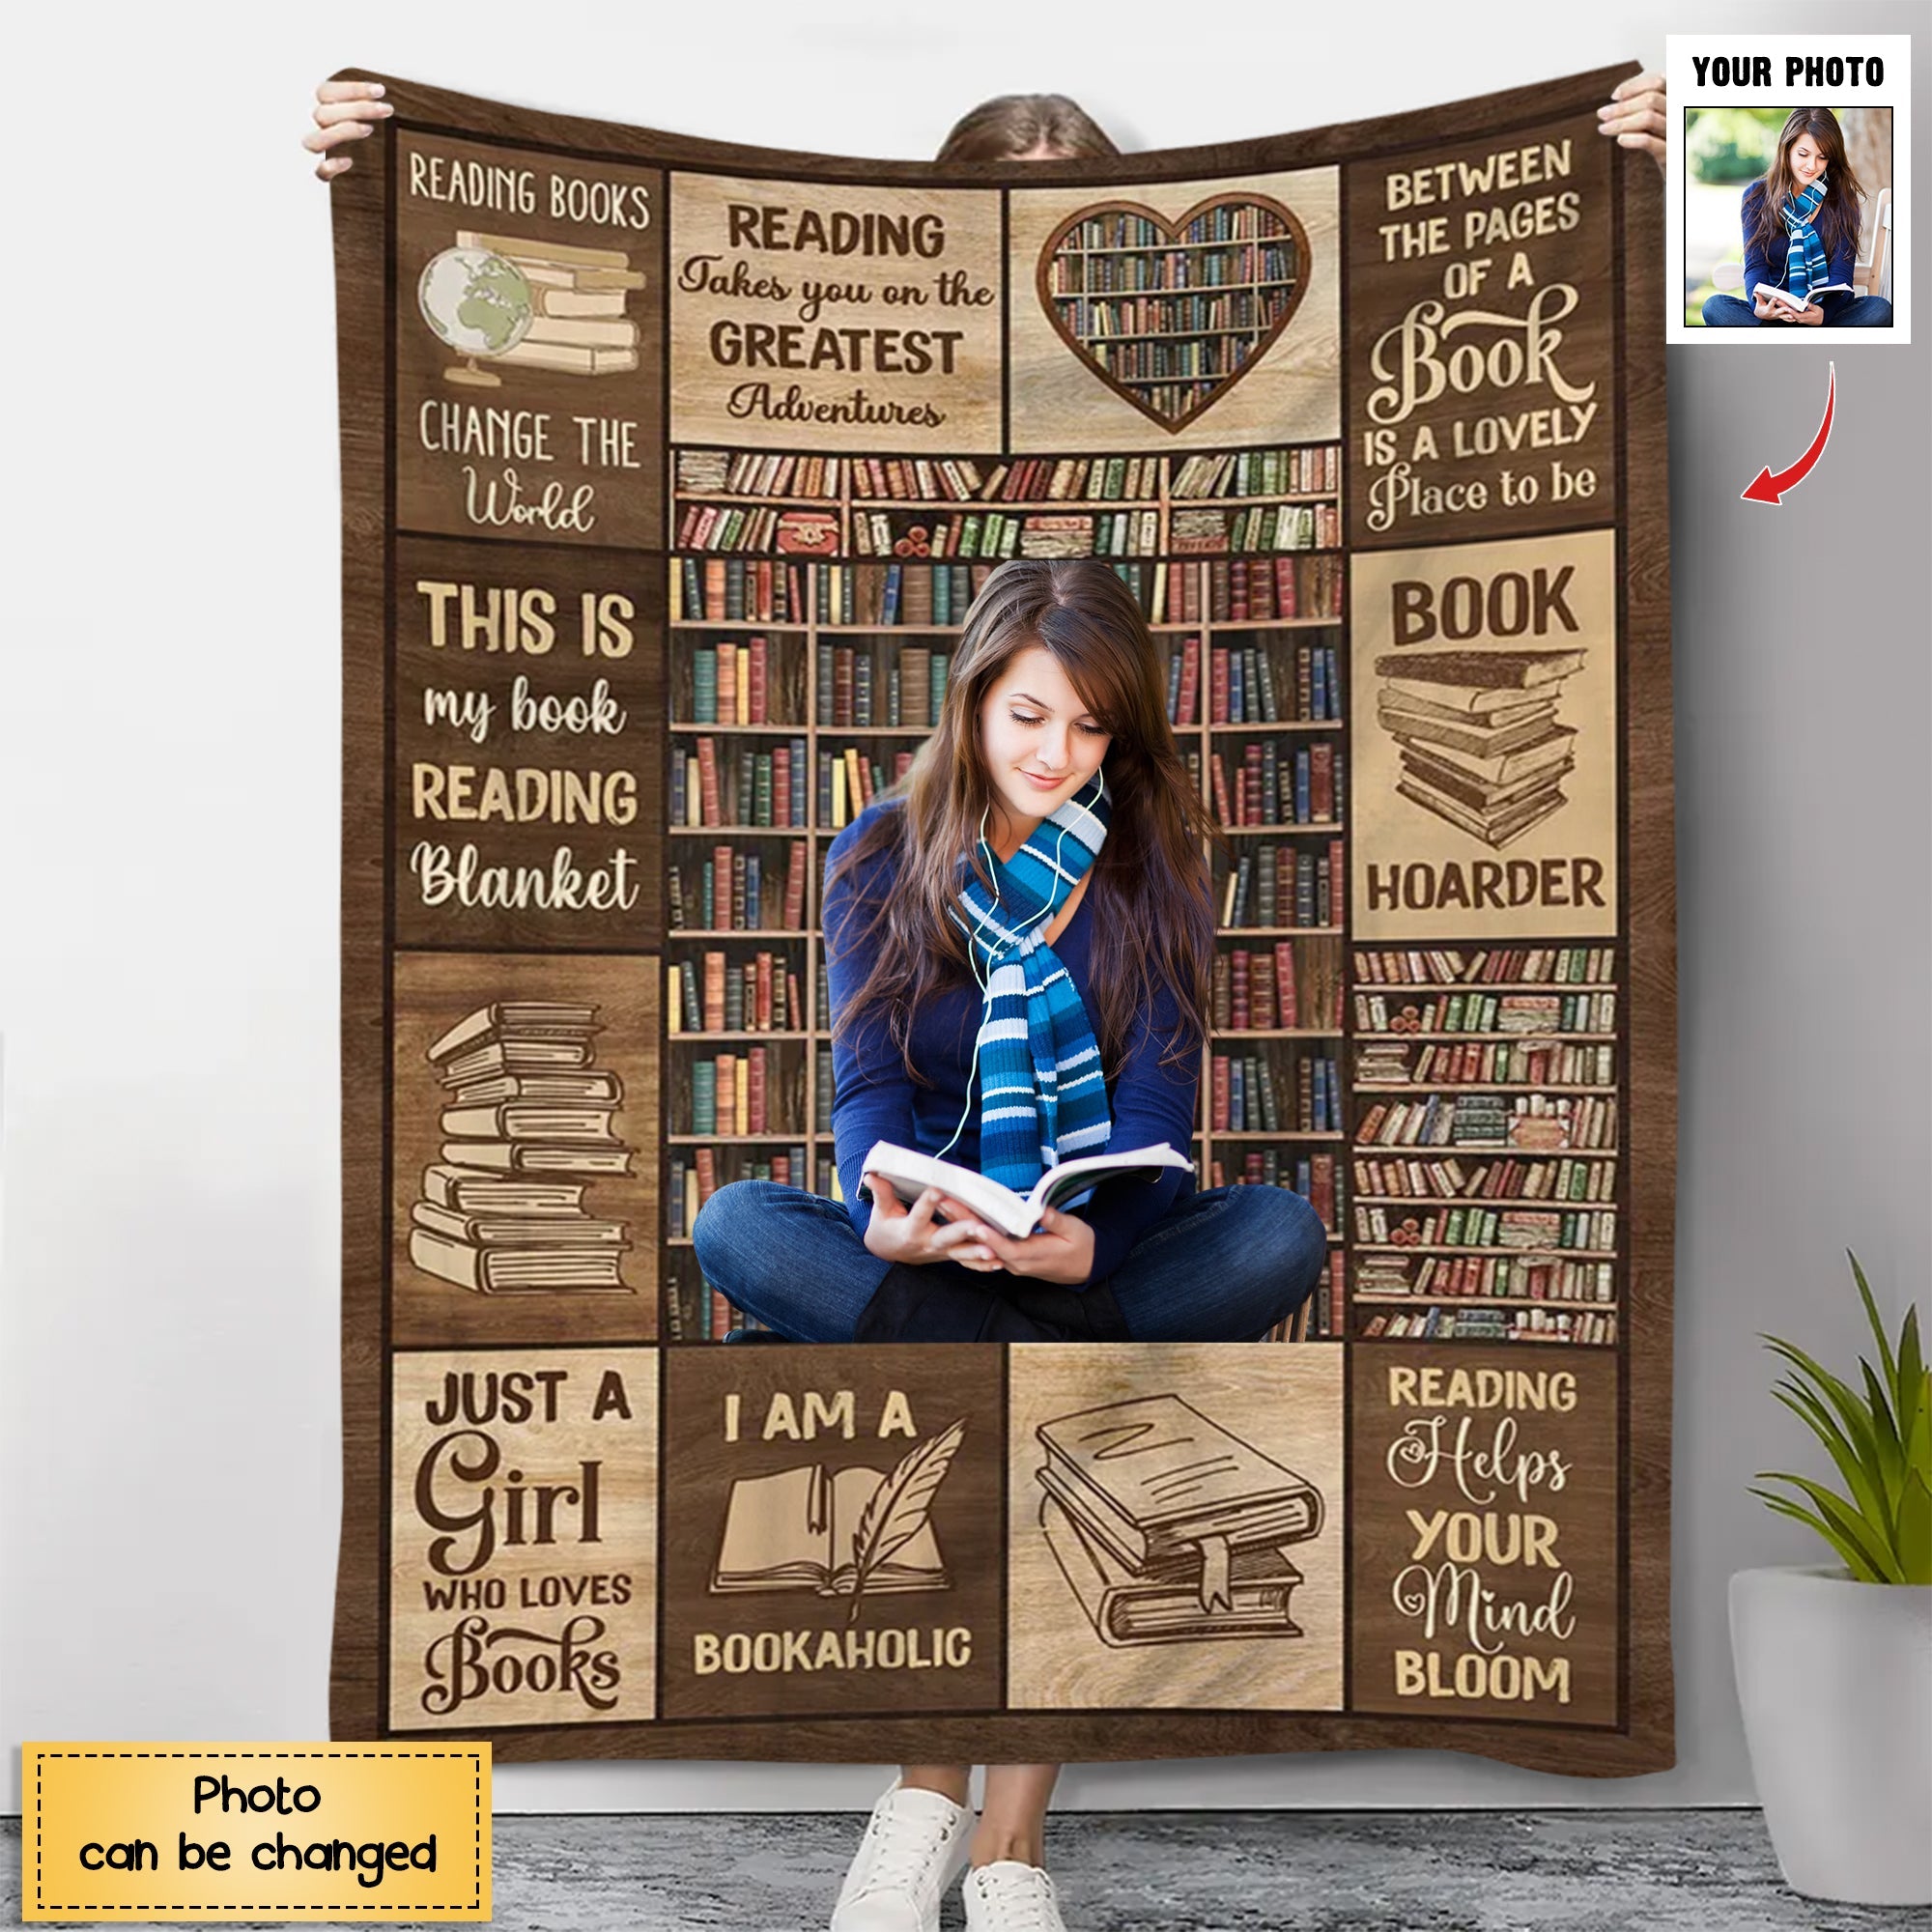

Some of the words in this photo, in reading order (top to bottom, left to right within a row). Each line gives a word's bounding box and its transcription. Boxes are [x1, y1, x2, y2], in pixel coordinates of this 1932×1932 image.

[410, 153, 534, 213] READING
[551, 174, 651, 230] BOOKS
[1385, 139, 1573, 212] BETWEEN
[727, 204, 946, 259] READING
[1379, 219, 1450, 261] THE
[1464, 192, 1580, 249] PAGES
[678, 254, 791, 301] Takes
[801, 275, 873, 322] you
[881, 285, 928, 306] on
[933, 271, 994, 307] the
[1443, 259, 1492, 300] OF
[1507, 251, 1534, 288] A
[709, 320, 964, 374] GREATEST
[1367, 283, 1595, 425] Book
[419, 400, 554, 462] CHANGE
[574, 415, 640, 469] THE
[726, 383, 947, 428] Adventures
[1363, 430, 1396, 467] IS
[1412, 425, 1438, 460] A
[1454, 403, 1598, 458] LOVELY
[463, 466, 596, 532] World
[1367, 462, 1488, 531] Place
[1500, 471, 1539, 506] to
[1550, 462, 1596, 499] be
[416, 581, 556, 654] THIS
[582, 592, 635, 658] IS
[1391, 565, 1579, 646] BOOK
[424, 687, 497, 744] my
[511, 675, 627, 735] book
[412, 763, 638, 826] READING
[411, 840, 639, 911] Blanket
[1367, 857, 1606, 911] HOARDER
[425, 1371, 568, 1427] JUST
[592, 1370, 633, 1421] A
[724, 1393, 740, 1441] I
[762, 1389, 857, 1440] AM
[877, 1389, 918, 1438] A
[1388, 1366, 1577, 1411] READING
[1387, 1414, 1572, 1505] Helps
[414, 1429, 603, 1577] Girl
[1406, 1509, 1561, 1569] YOUR
[422, 1577, 505, 1611] WHO
[520, 1573, 633, 1608] LOVES
[1392, 1562, 1576, 1655] Mind
[421, 1614, 621, 1716] Books
[694, 1626, 972, 1676] BOOKAHOLIC
[1394, 1650, 1572, 1703] BLOOM
